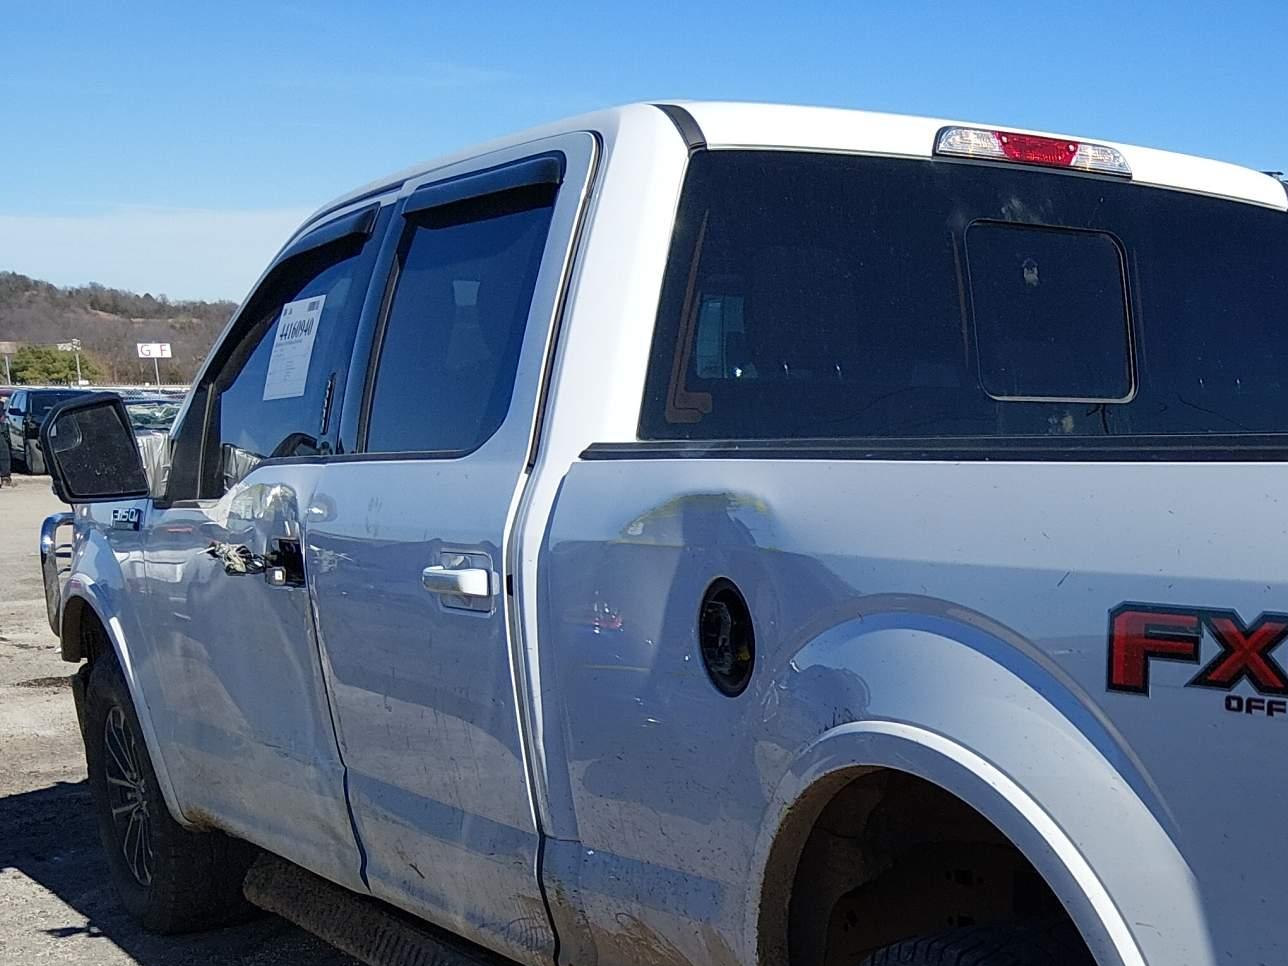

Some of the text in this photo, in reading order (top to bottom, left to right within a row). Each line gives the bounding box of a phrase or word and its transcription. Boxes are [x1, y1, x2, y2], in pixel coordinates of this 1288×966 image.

[279, 318, 315, 341] 44160940
[140, 344, 169, 357] G F
[1224, 695, 1287, 717] OFF
